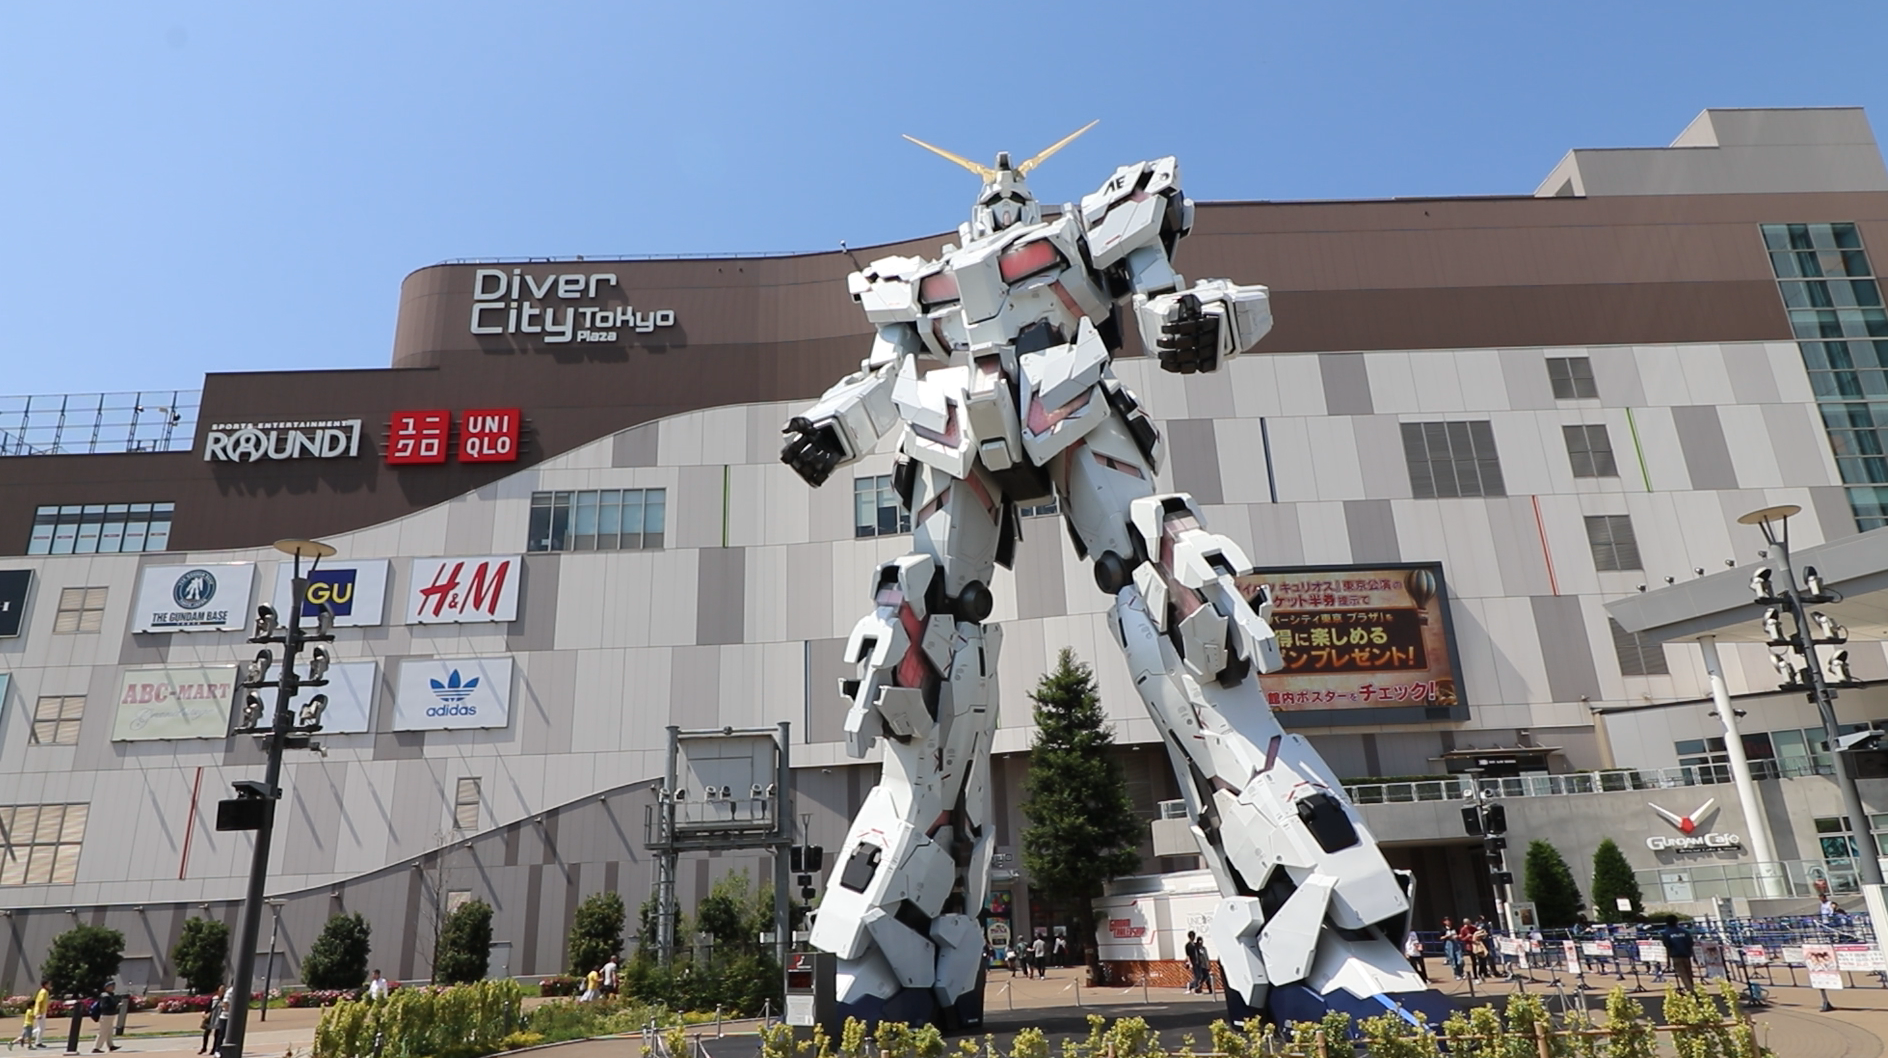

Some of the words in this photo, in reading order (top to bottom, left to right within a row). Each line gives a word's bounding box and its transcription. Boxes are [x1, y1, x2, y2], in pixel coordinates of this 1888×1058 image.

[474, 268, 617, 300] Diver
[470, 301, 575, 343] City
[577, 330, 617, 342] Plaza
[257, 420, 347, 429] ENTERTAINMENT
[204, 419, 362, 463] ROUND1
[307, 582, 352, 604] GU
[417, 560, 511, 618] H&M
[153, 612, 168, 622] THE
[169, 611, 205, 622] GUNDAM
[206, 610, 228, 621] BASE
[121, 682, 230, 704] ABC-MART
[426, 704, 477, 717] adidas
